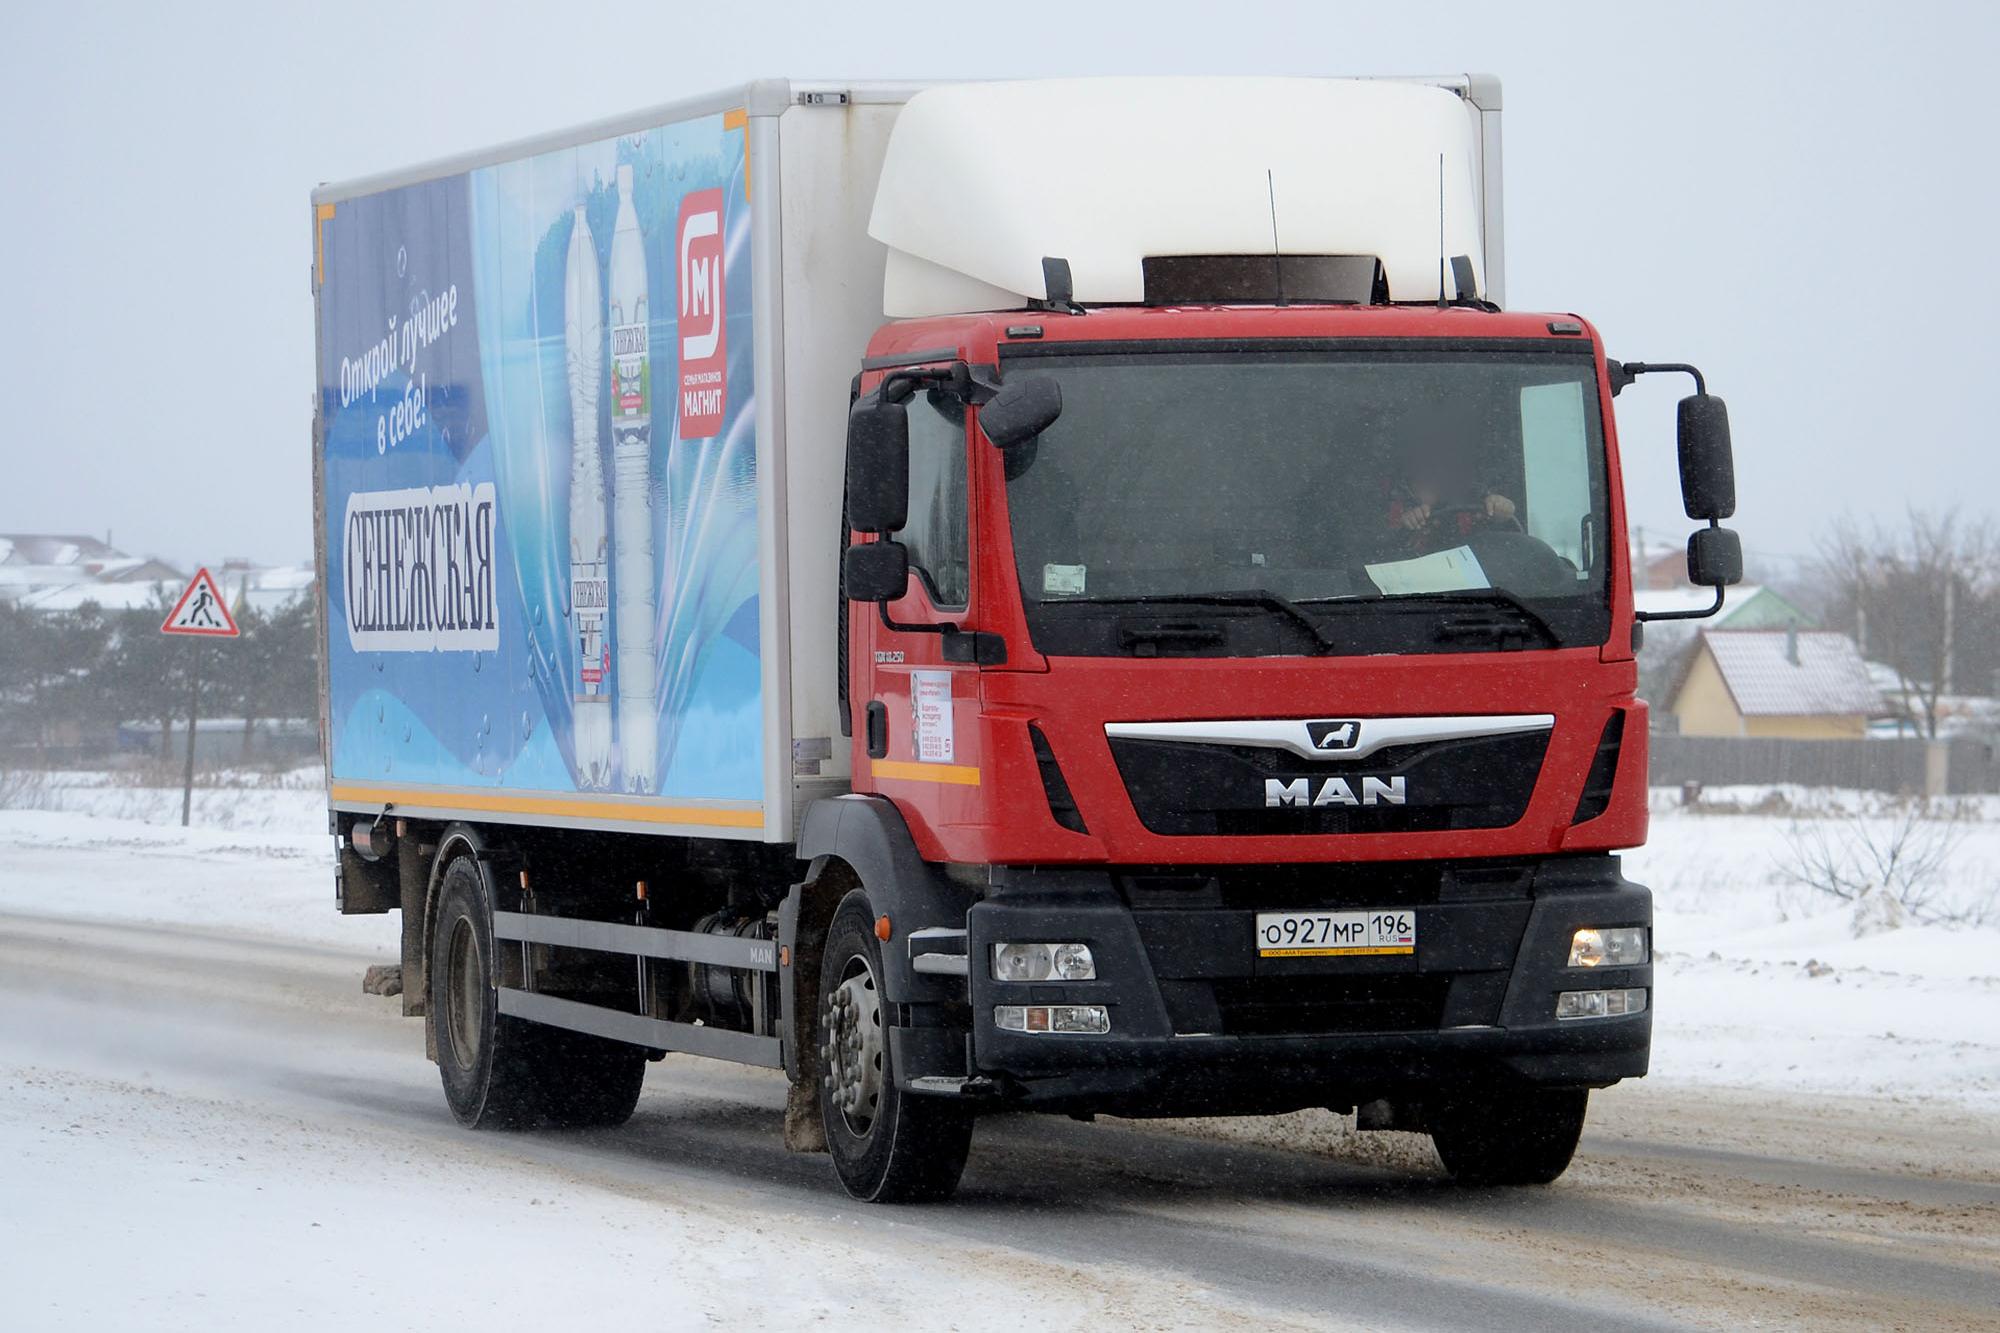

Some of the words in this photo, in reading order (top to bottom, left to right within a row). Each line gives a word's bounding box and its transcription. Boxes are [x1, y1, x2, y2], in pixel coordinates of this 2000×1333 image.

[340, 317, 398, 409] Открой
[401, 284, 458, 374] лучшее
[377, 413, 387, 455] в
[388, 371, 427, 450] себе!
[685, 389, 722, 417] МАГНИТ
[348, 501, 495, 632] СЕНЕЖСКАЯ
[1265, 776, 1406, 807] MAN
[1372, 914, 1408, 935] 196
[1379, 935, 1398, 943] RUS
[751, 948, 772, 964] MAN
